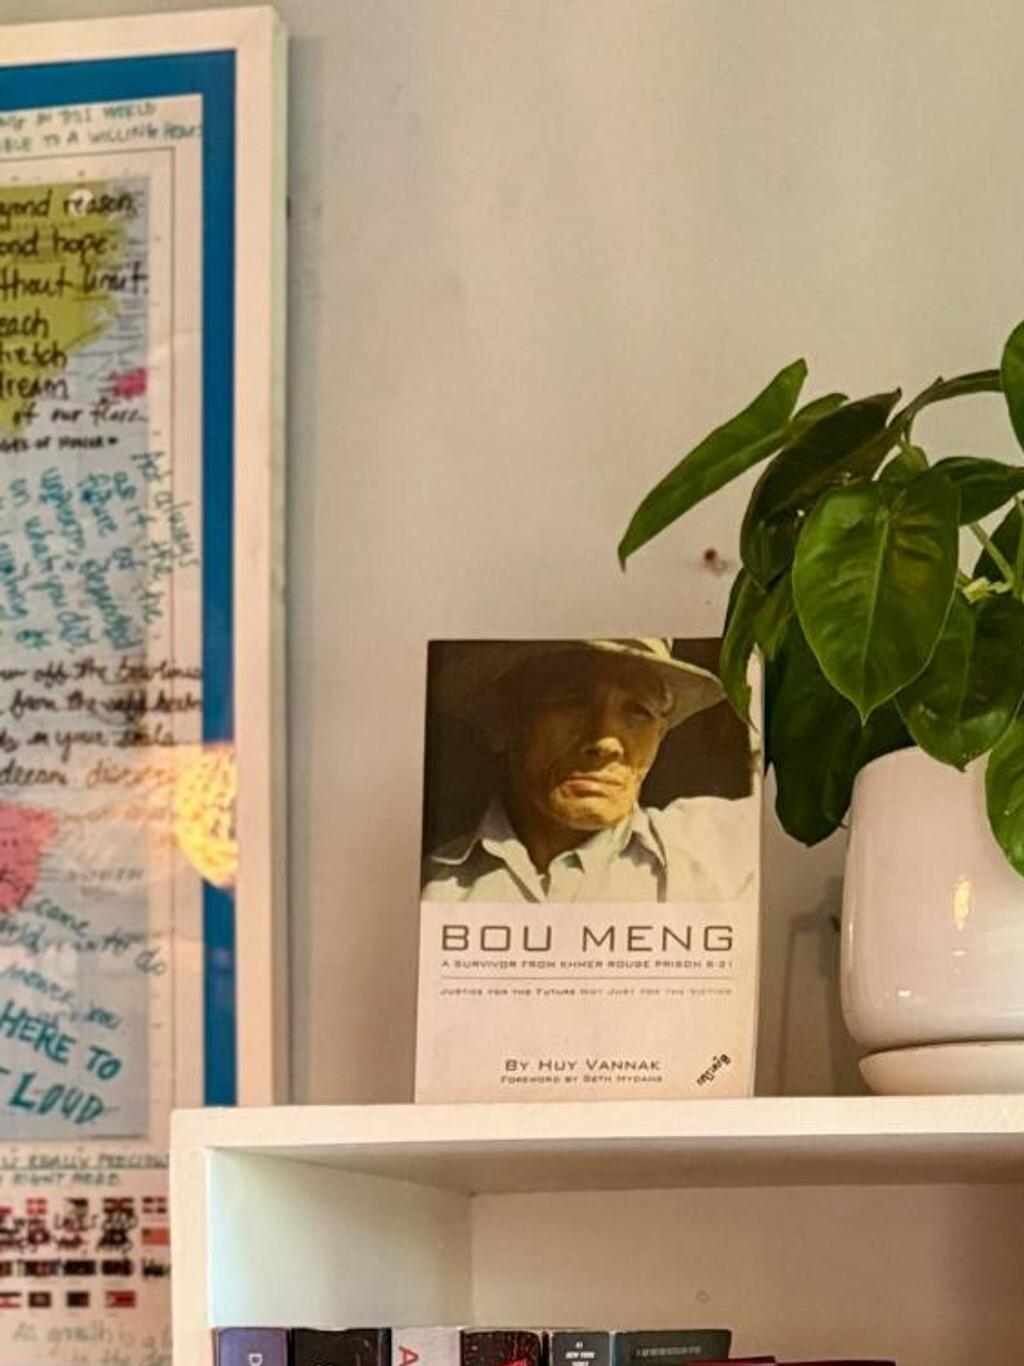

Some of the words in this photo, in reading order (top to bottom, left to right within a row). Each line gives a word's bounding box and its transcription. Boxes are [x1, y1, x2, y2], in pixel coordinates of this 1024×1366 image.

[441, 924, 552, 952] BOU
[581, 925, 734, 953] MENG
[0, 1001, 77, 1065] HERE
[86, 1046, 121, 1081] TO
[9, 1072, 104, 1124] LOUD
